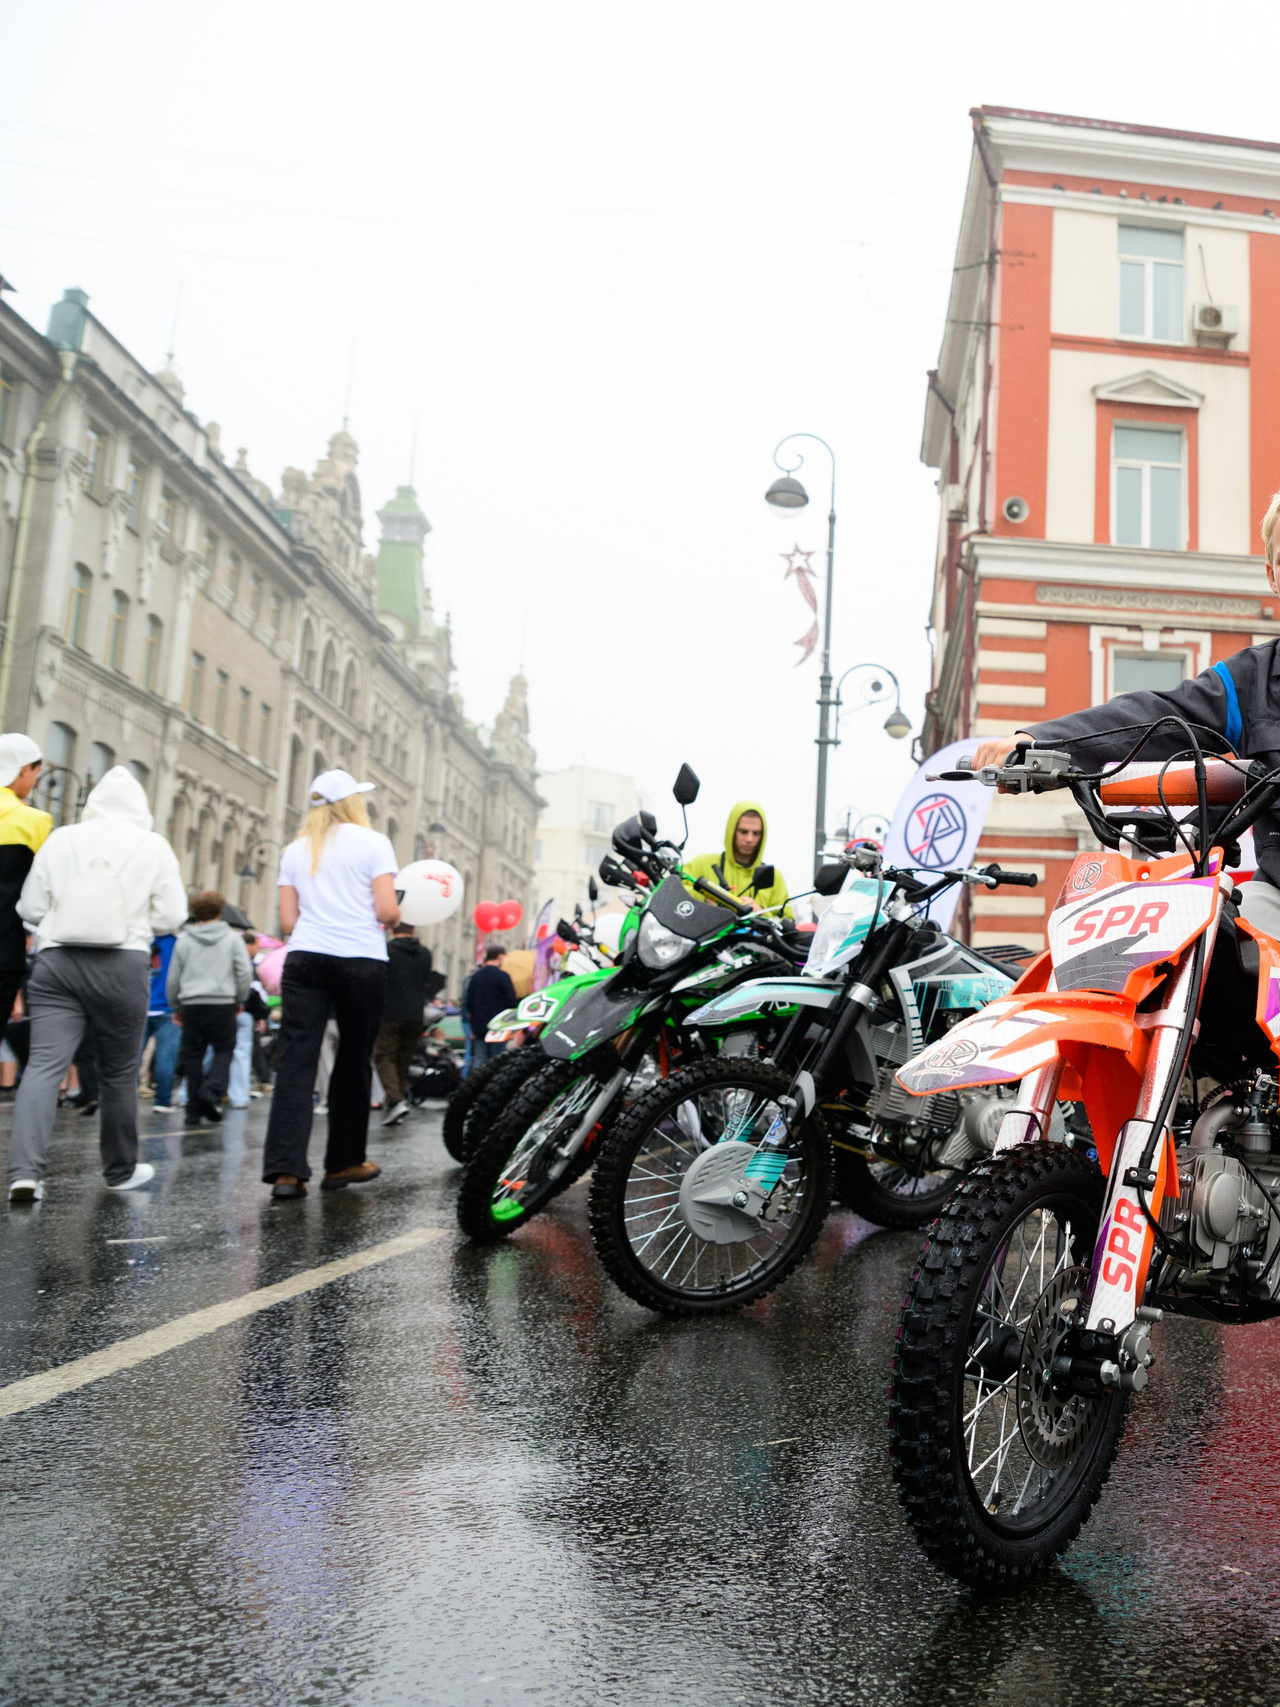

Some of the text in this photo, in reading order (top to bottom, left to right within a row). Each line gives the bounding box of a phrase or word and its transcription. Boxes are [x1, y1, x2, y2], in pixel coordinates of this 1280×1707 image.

[1067, 901, 1170, 946] SPR
[981, 977, 1006, 995] SPR
[1102, 1197, 1145, 1293] SPR
